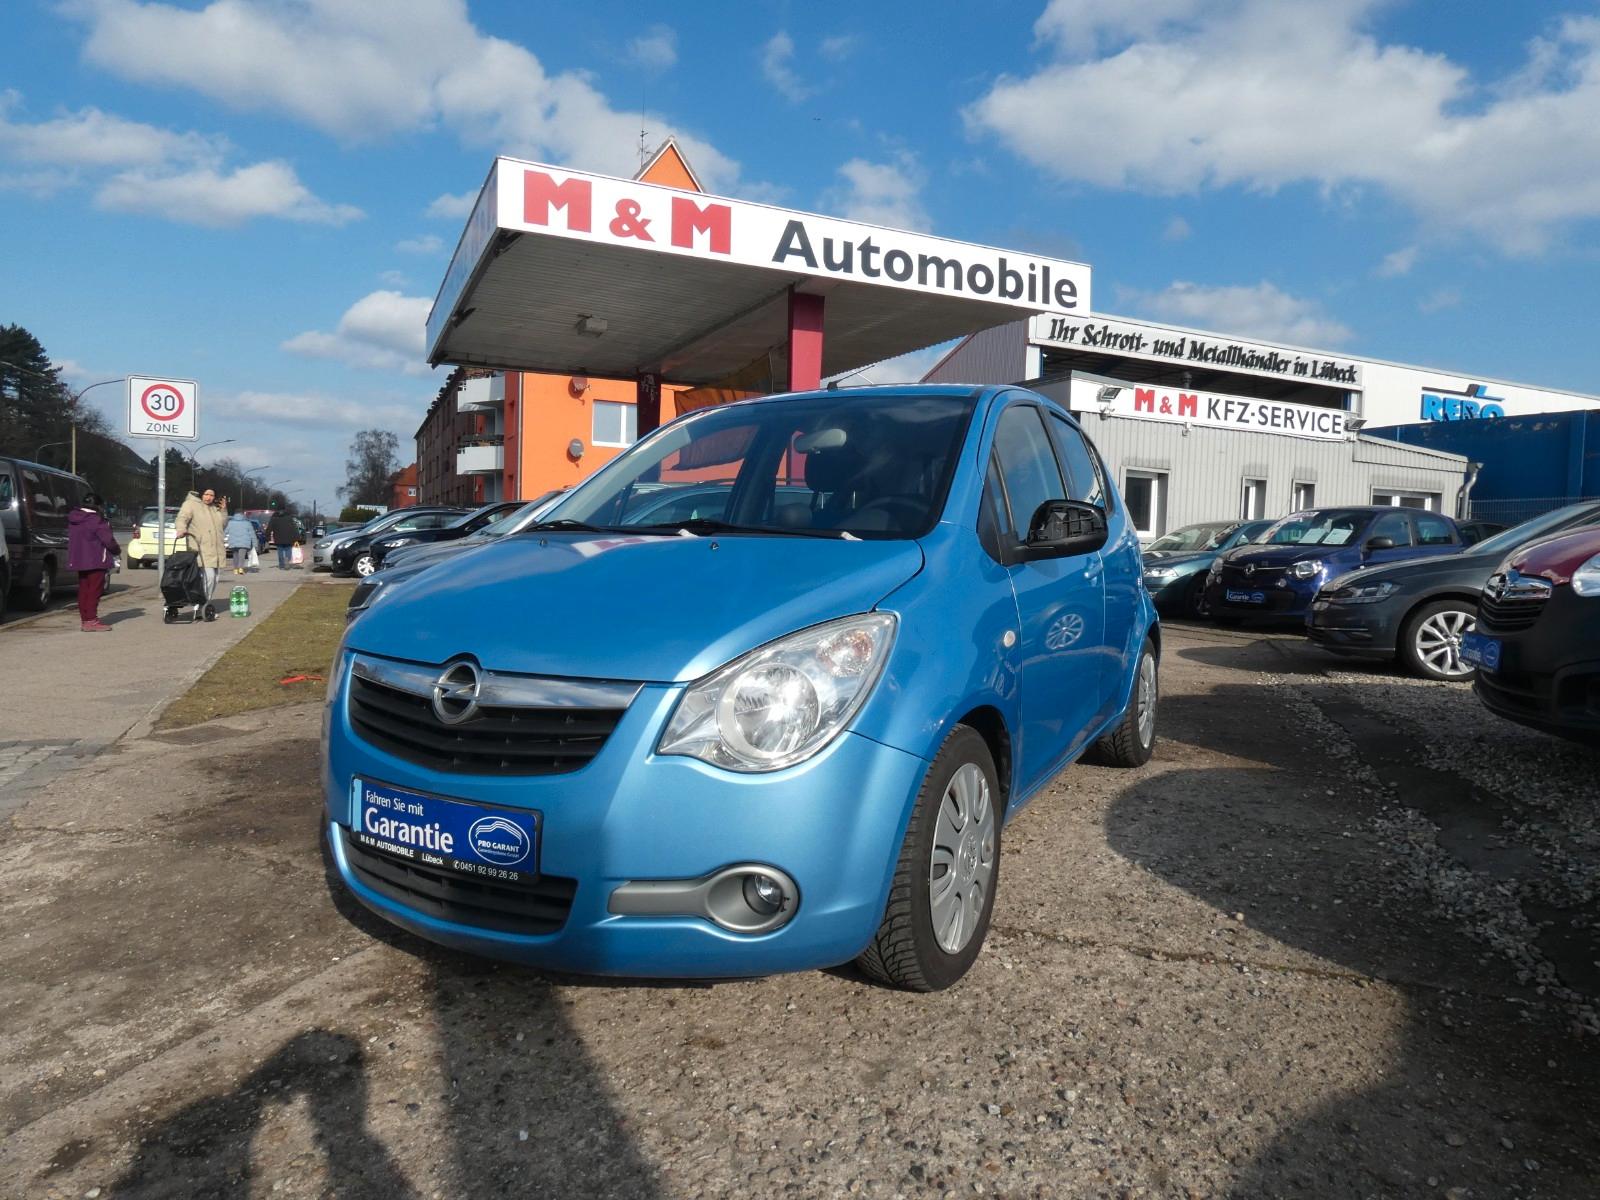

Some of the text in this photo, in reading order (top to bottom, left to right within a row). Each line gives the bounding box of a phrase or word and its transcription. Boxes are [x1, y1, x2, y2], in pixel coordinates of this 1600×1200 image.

[523, 170, 1078, 308] M & M Automobile
[1049, 318, 1358, 383] Ihr Schrott- und Metallhändler in Lübeck
[150, 393, 176, 411] 30
[1134, 387, 1155, 413] M
[1159, 395, 1173, 414] &
[1178, 394, 1198, 417] M
[146, 422, 179, 434] ZONE
[365, 790, 424, 817] Fahren Sie mit
[365, 807, 454, 853] Garantie
[376, 840, 415, 858] AUTOMOBILE
[477, 840, 520, 853] PRO GARANT
[421, 852, 444, 866] Lübeck
[460, 861, 519, 881] 0451 92 99 26 26
